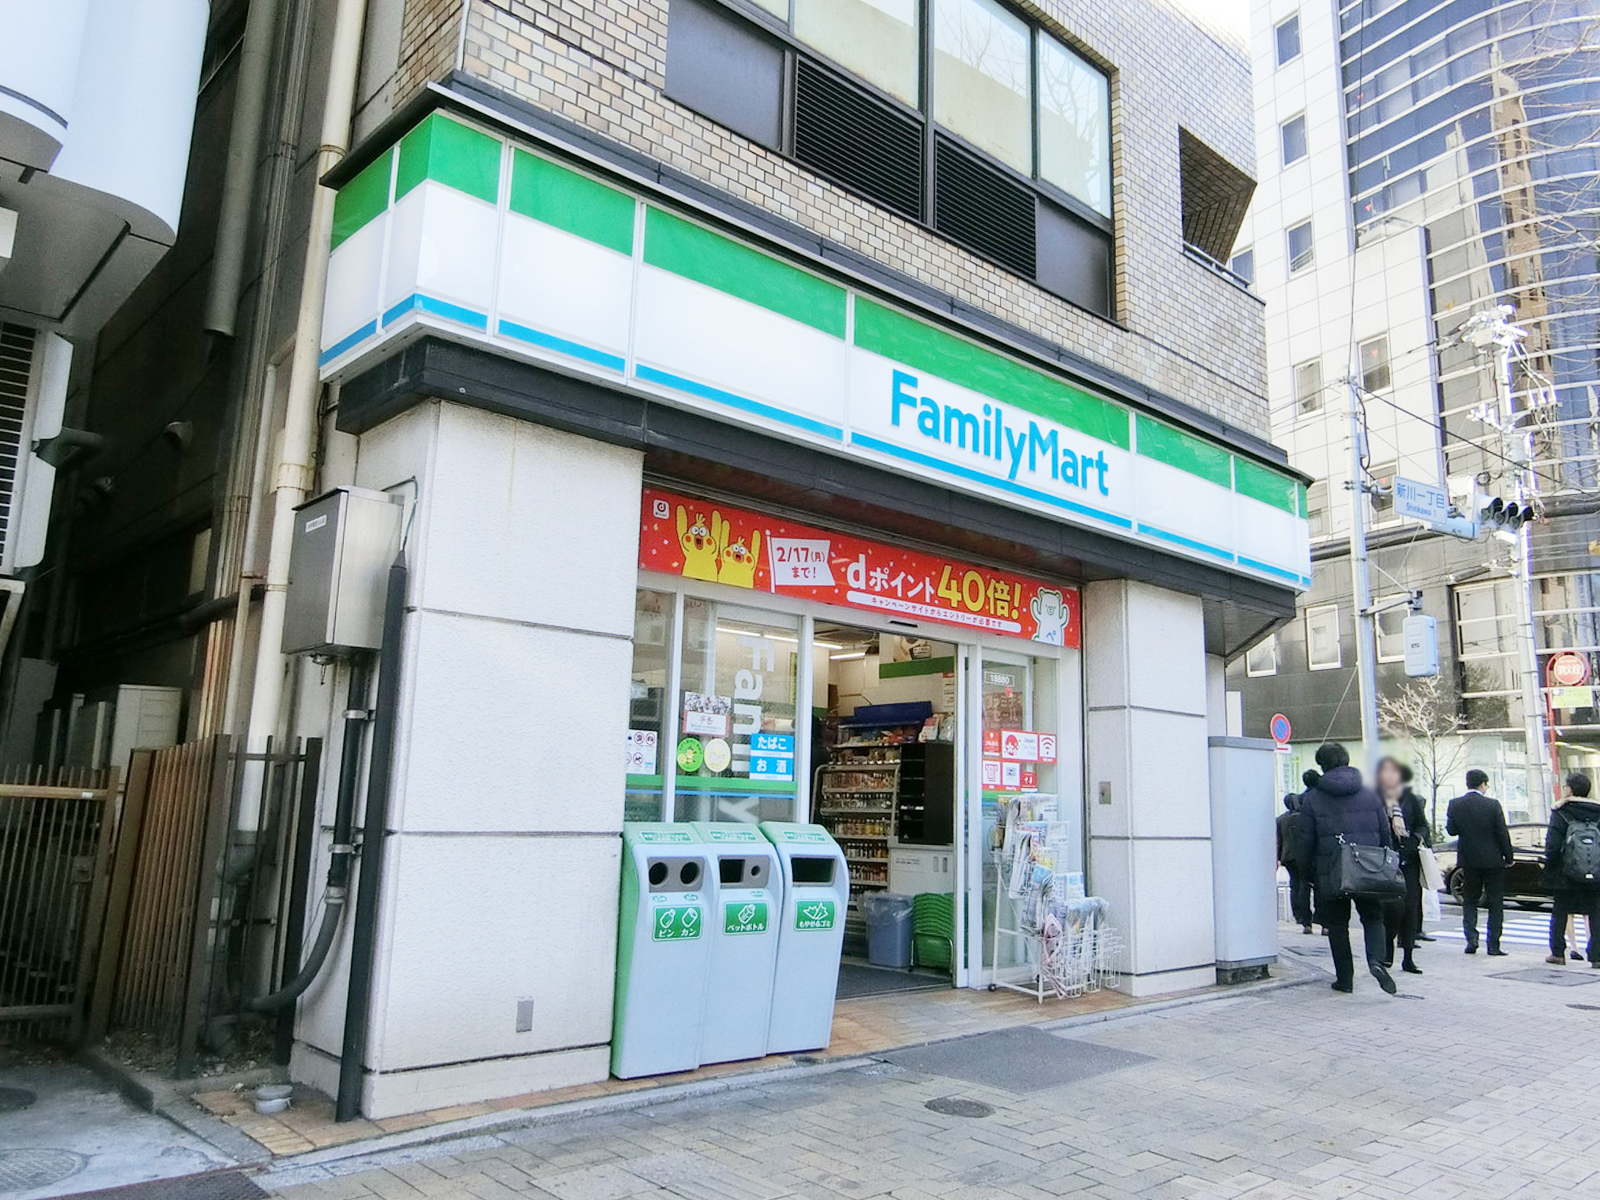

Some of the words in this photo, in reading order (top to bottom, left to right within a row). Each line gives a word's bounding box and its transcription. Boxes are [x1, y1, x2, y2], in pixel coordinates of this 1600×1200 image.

[891, 369, 1109, 496] FamilyMart
[1396, 482, 1445, 509] 新川一丁目
[1405, 502, 1432, 516] Shinkawa
[1557, 664, 1581, 676] 消火栓
[757, 736, 787, 750] たばこ
[727, 923, 764, 932] ペットボトル
